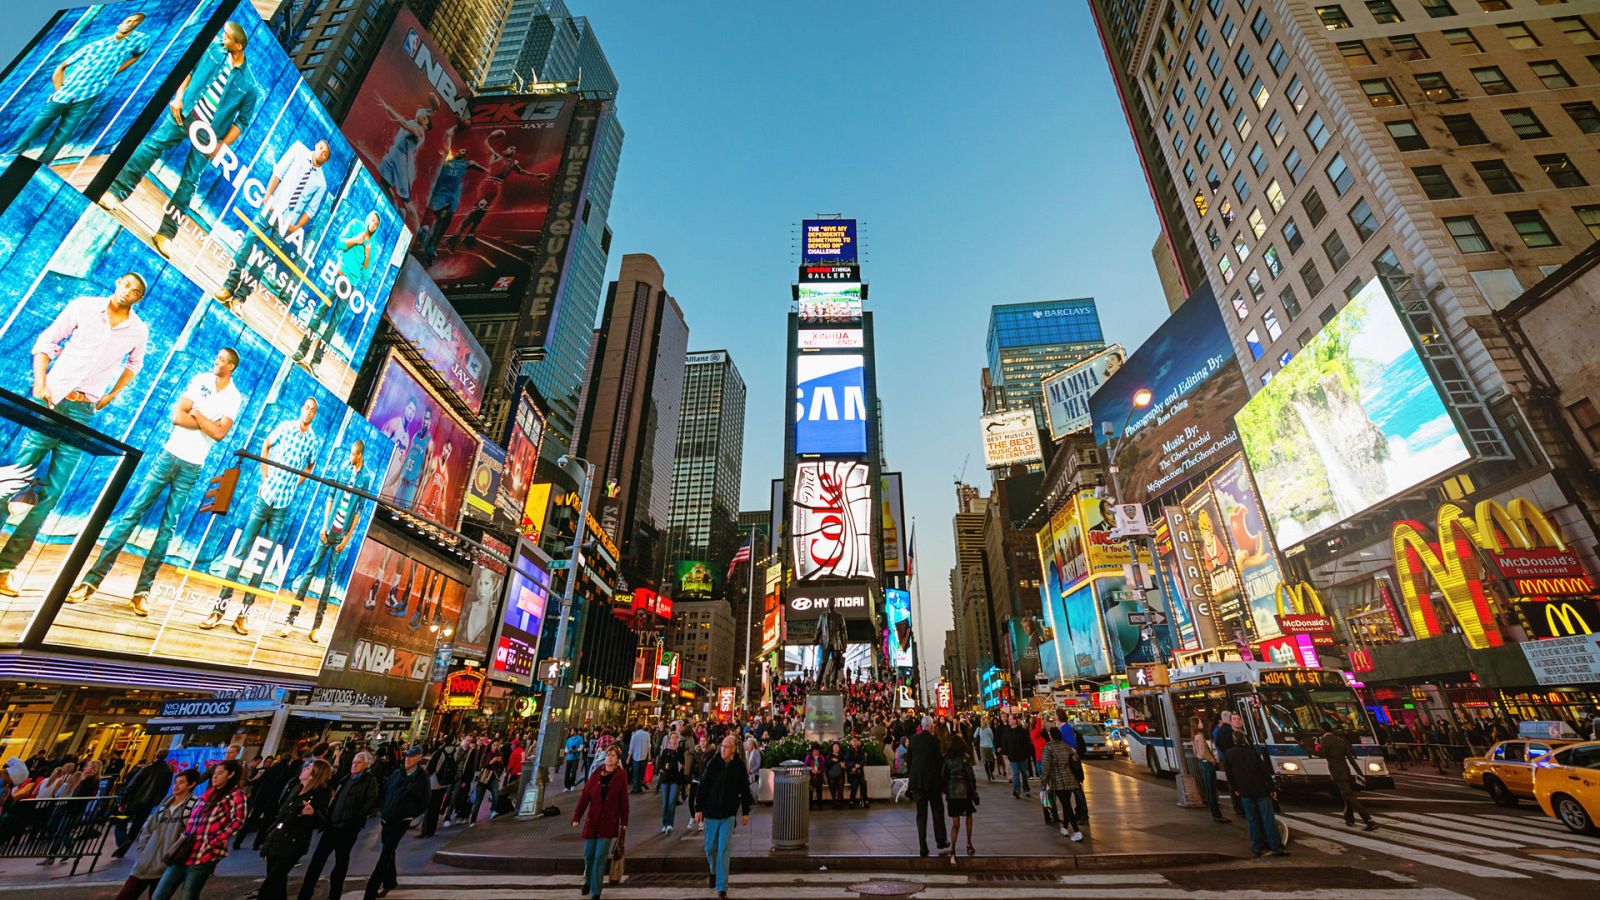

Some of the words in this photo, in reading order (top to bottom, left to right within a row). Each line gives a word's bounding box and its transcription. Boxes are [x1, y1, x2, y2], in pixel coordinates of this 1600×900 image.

[413, 41, 471, 120] NBA
[564, 116, 596, 193] TIMES
[163, 200, 238, 272] UNLIMITED
[188, 119, 317, 270] ORIGINAL
[320, 259, 377, 322] BOOT
[530, 202, 572, 317] SQUARE
[421, 294, 453, 342] NBA
[1044, 306, 1091, 318] BARCLAYS
[1049, 367, 1100, 405] MAMMA
[1124, 401, 1165, 438] Photography
[1164, 387, 1180, 407] and
[1178, 366, 1209, 395] Editing
[1207, 354, 1224, 372] By:
[989, 441, 1009, 450] THE
[1009, 436, 1035, 447] BEST
[989, 446, 1024, 457] MUSICAL
[1025, 443, 1037, 451] OF
[1004, 431, 1034, 439] MUSICAL
[1159, 458, 1172, 471] The
[1171, 448, 1190, 464] Ghost
[1188, 430, 1212, 451] Orchid
[1161, 432, 1185, 456] Music
[1184, 424, 1200, 440] By:
[810, 472, 845, 568] Coke
[222, 527, 295, 591] LEN
[1174, 513, 1211, 617] PALACE
[1499, 555, 1577, 568] McDonald's
[1517, 567, 1569, 575] Restaurant
[1210, 567, 1238, 593] Annie
[813, 596, 865, 609] HYNDAI
[1282, 619, 1330, 628] McDonald's
[358, 640, 396, 674] NBA
[389, 648, 432, 680] 2K13
[450, 677, 480, 694] ROXY
[1307, 672, 1321, 684] ST
[178, 702, 201, 716] HOT
[201, 701, 231, 715] DOGS
